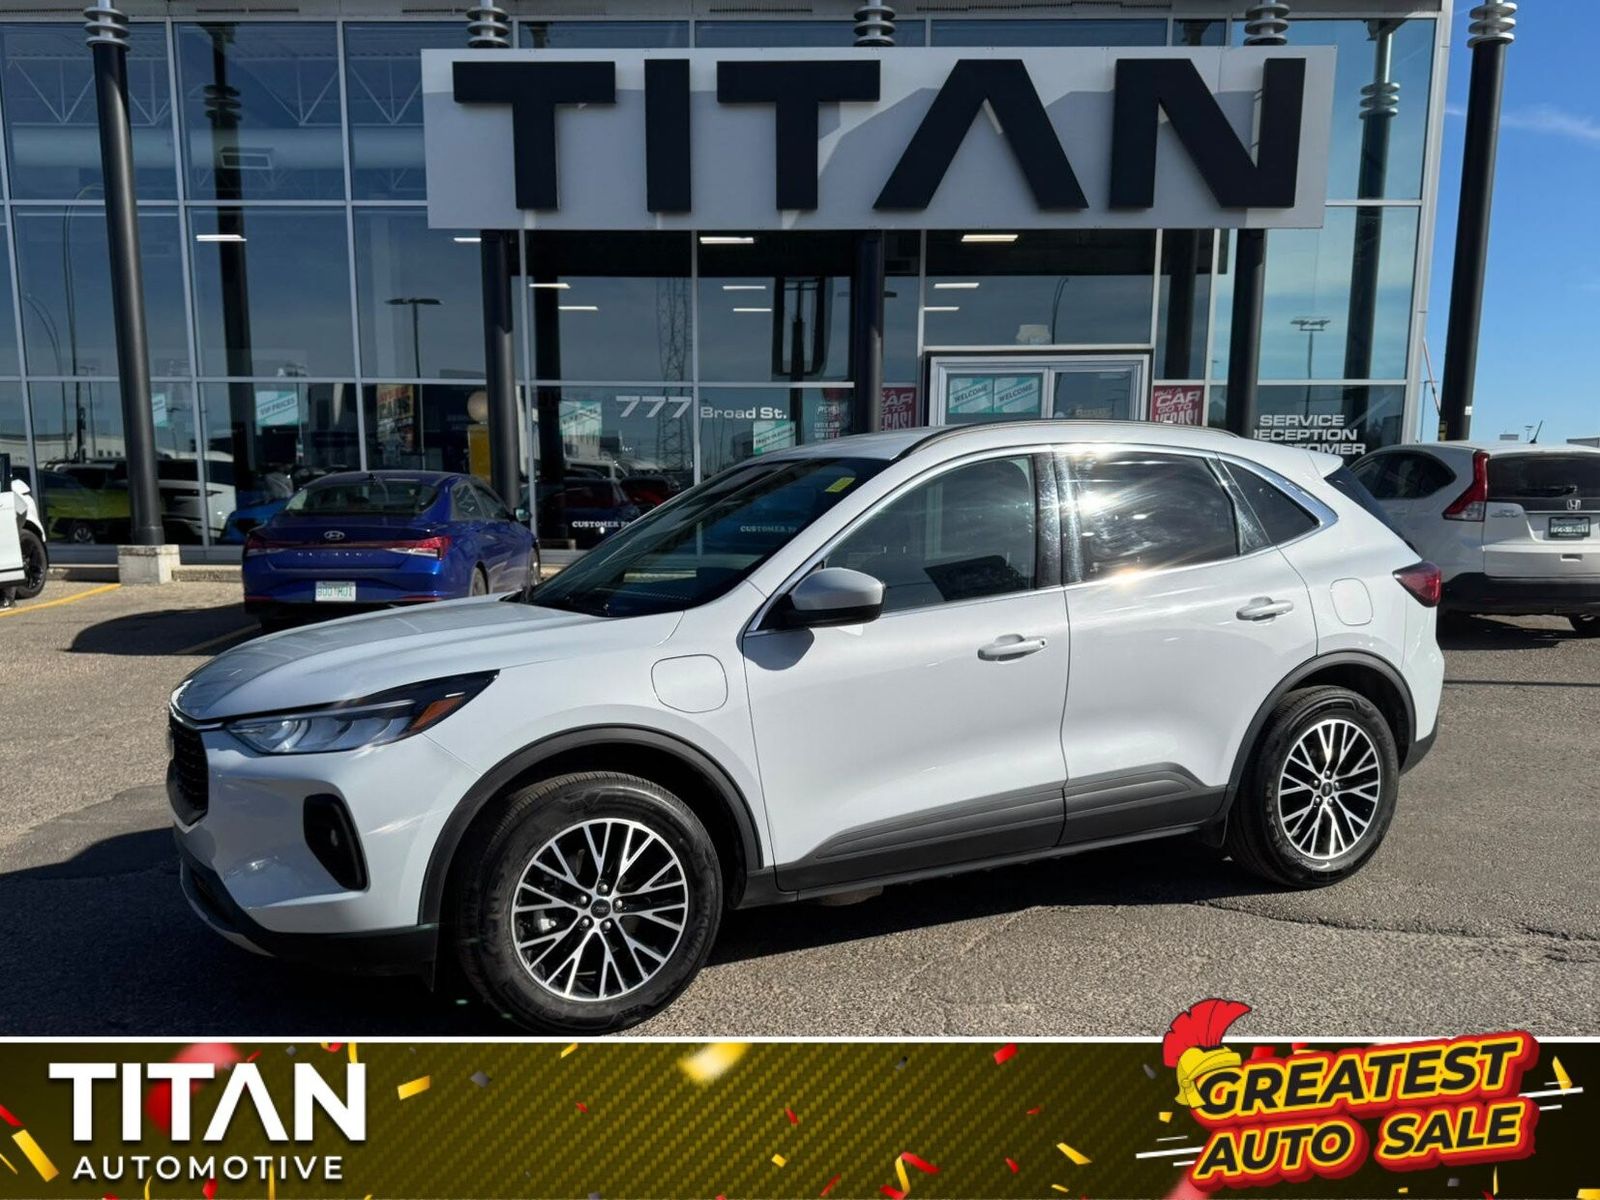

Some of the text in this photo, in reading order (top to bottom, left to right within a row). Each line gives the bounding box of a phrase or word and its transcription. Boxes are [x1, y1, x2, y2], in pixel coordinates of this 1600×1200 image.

[451, 57, 1307, 213] TITAN
[881, 393, 914, 407] AR
[954, 384, 988, 402] WELCOME
[1000, 382, 1034, 401] WELCOME
[1156, 391, 1201, 407] CAR
[615, 395, 787, 419] 777 Broad St.
[881, 411, 912, 431] GAS!
[1260, 415, 1345, 426] SERVICE
[1286, 443, 1366, 455] TOMER
[571, 520, 620, 528] CUSTOMER
